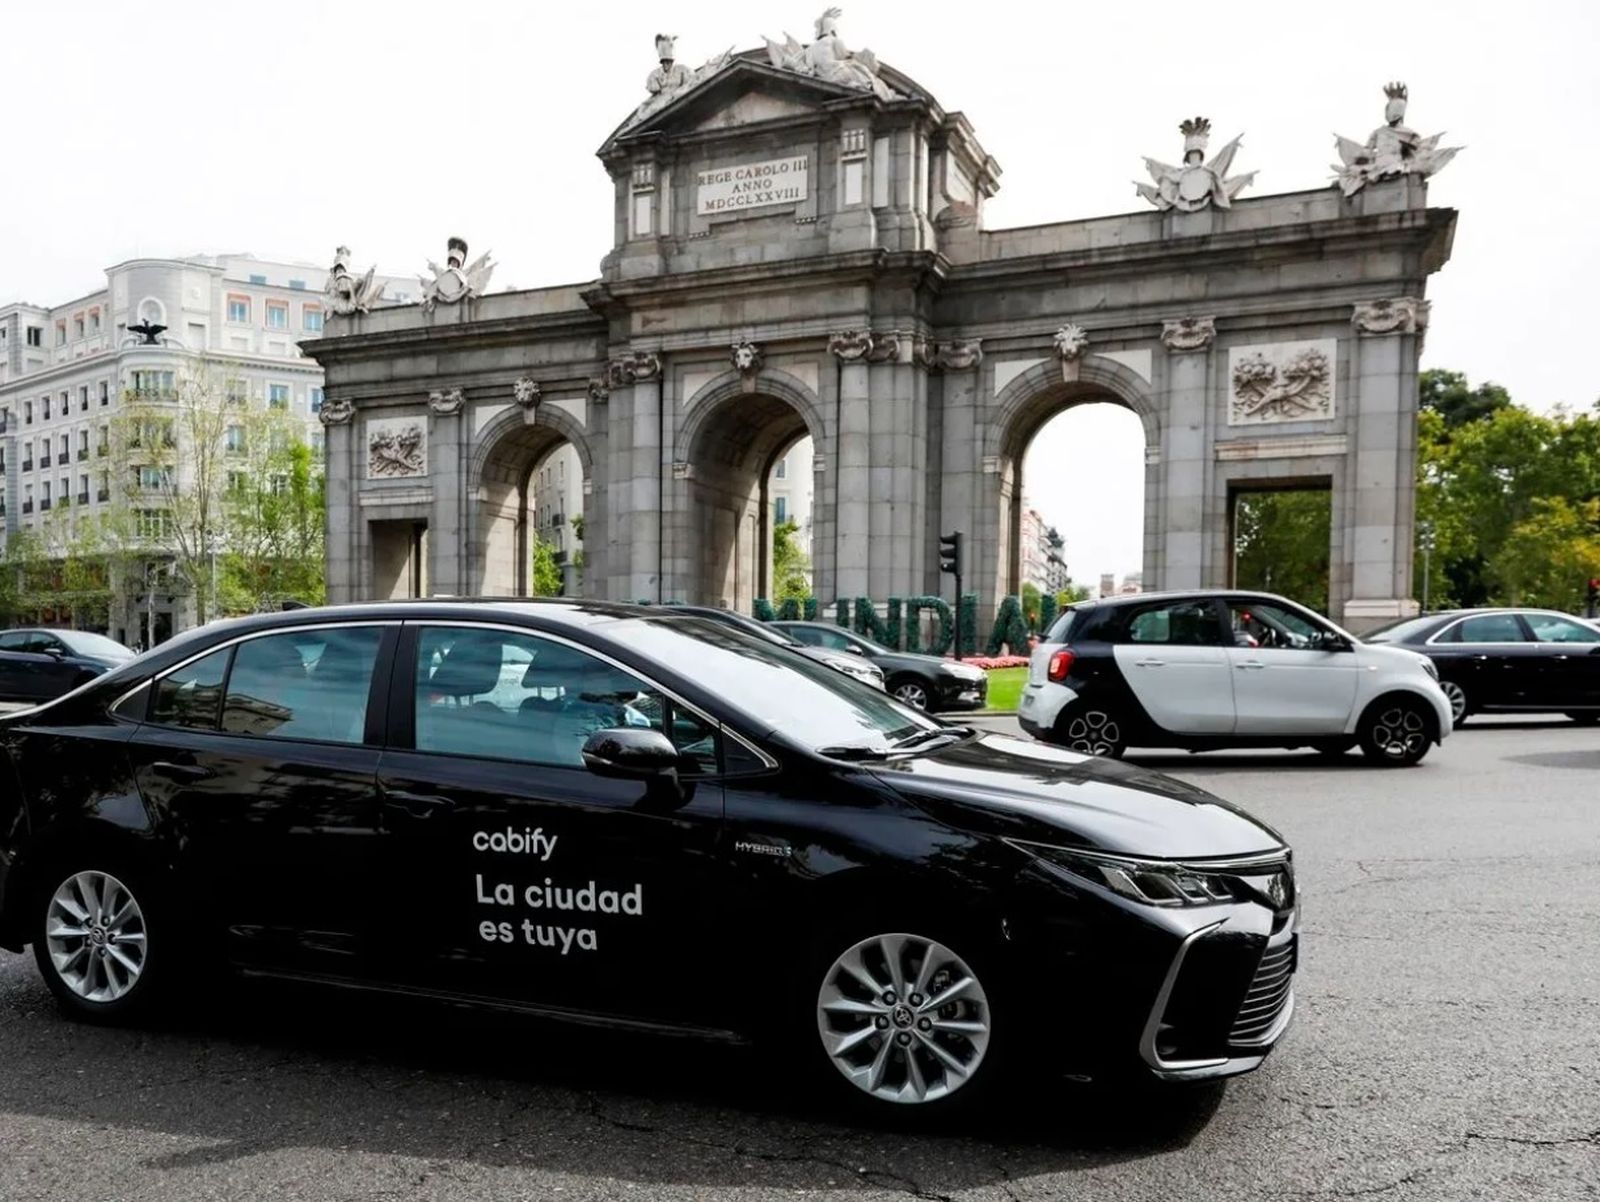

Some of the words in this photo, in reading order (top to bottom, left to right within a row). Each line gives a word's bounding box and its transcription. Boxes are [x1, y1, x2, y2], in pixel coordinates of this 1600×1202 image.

[698, 172, 732, 186] REGE
[735, 163, 789, 180] CAROLO
[793, 160, 808, 172] III
[732, 179, 772, 194] ANNO
[705, 187, 800, 211] MDCCLXXVIII
[472, 826, 558, 861] cabify
[476, 873, 515, 906] La
[524, 877, 643, 916] ciudad
[478, 920, 514, 943] es
[521, 918, 598, 956] tuya
